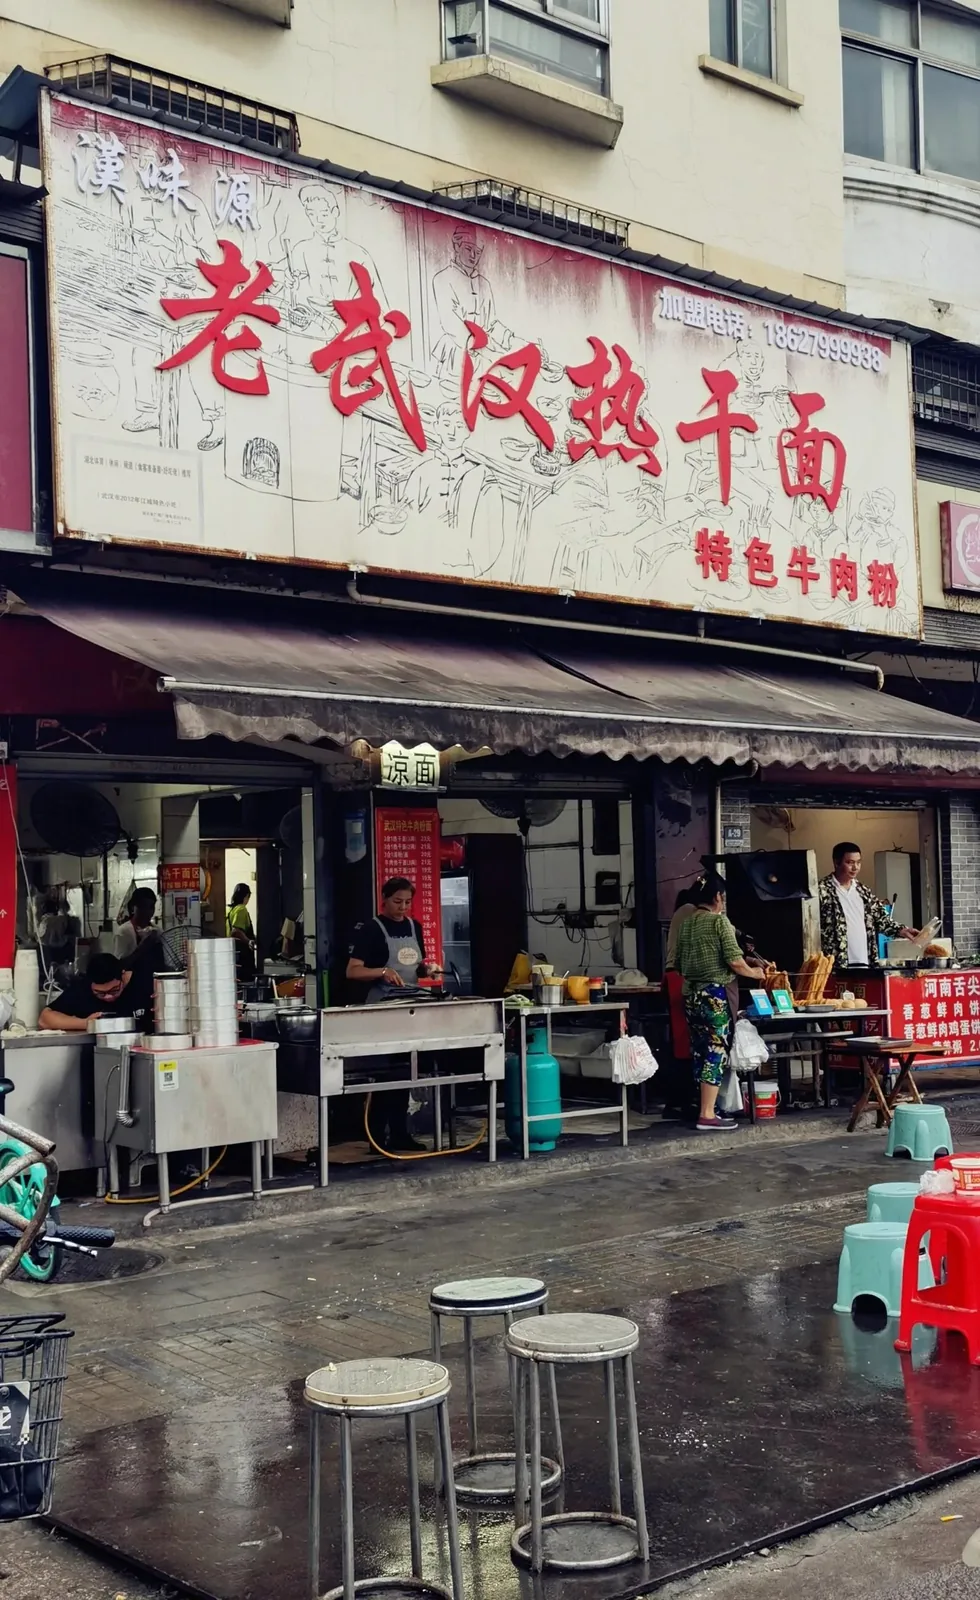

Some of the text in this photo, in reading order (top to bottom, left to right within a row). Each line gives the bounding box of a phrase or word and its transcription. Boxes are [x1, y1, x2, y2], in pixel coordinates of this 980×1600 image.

[764, 321, 883, 372] 18627999938
[156, 241, 847, 513] 老武汉热干面
[694, 528, 899, 608] 特色牛肉粉
[387, 750, 436, 787] 凉面
[728, 828, 741, 838] A-29
[924, 975, 980, 999] 河南舌尖
[903, 999, 980, 1021] 香葱鲜肉饼
[904, 1018, 980, 1039] 香葱鲜肉鸡蛋饼
[969, 1039, 980, 1052] 2.
